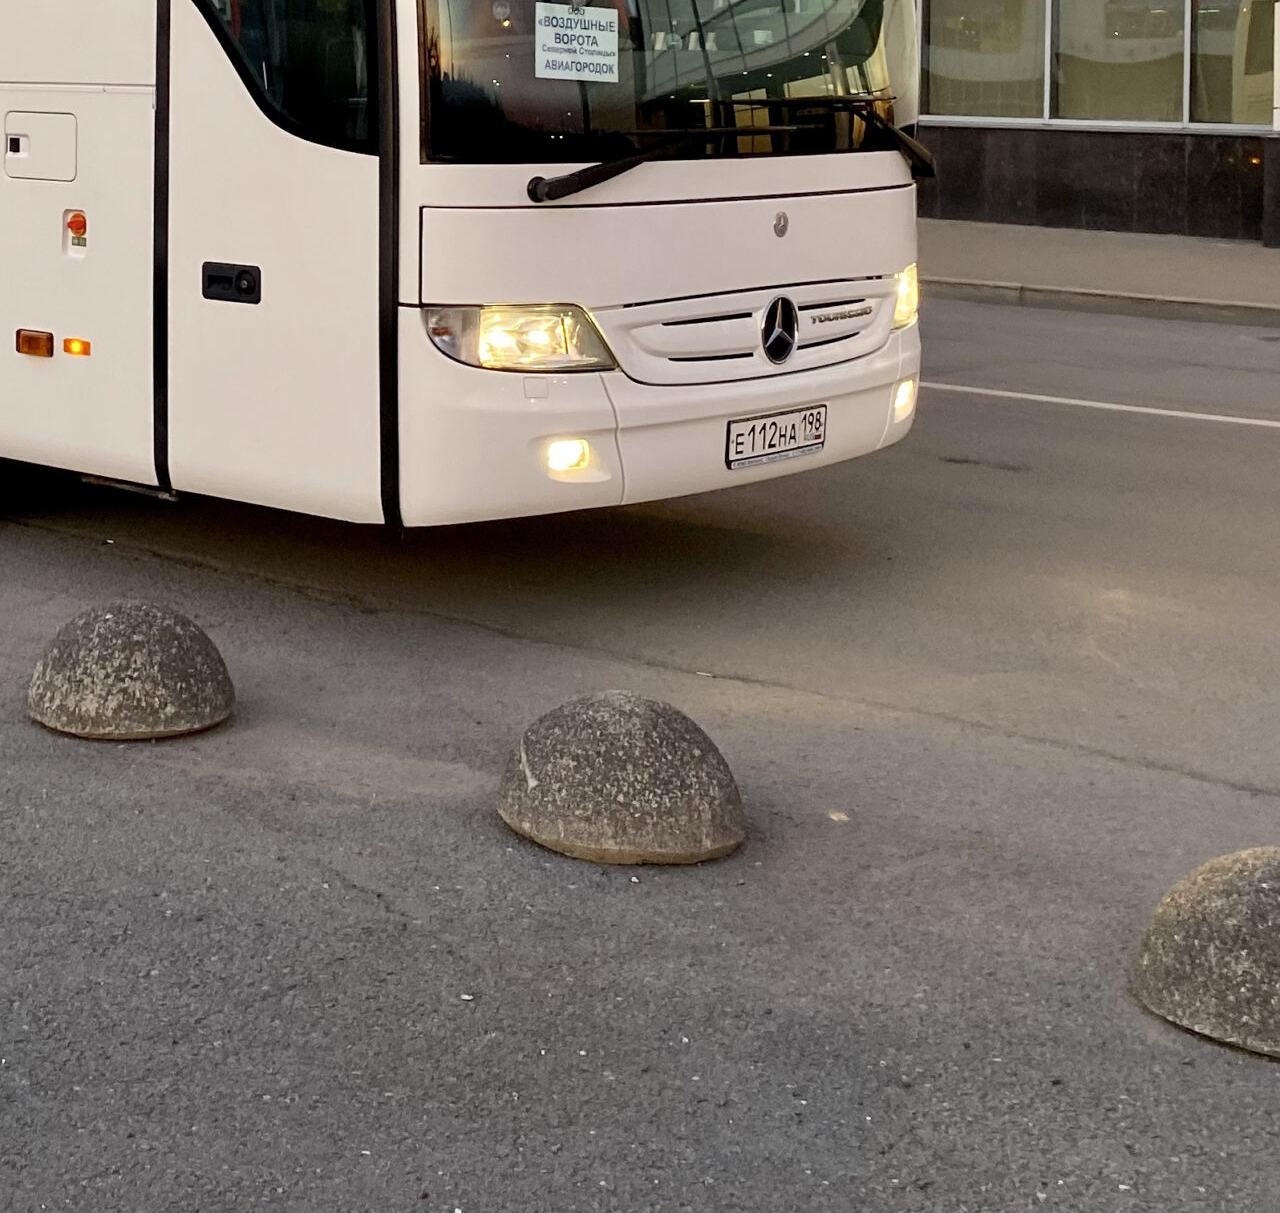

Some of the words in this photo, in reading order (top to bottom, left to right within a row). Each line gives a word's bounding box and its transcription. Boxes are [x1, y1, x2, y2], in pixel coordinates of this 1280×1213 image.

[538, 15, 616, 33] «ВОЗДУШНЫЕ
[554, 32, 599, 47] ВОРОТА
[544, 59, 615, 75] АВИАГОРОДОК
